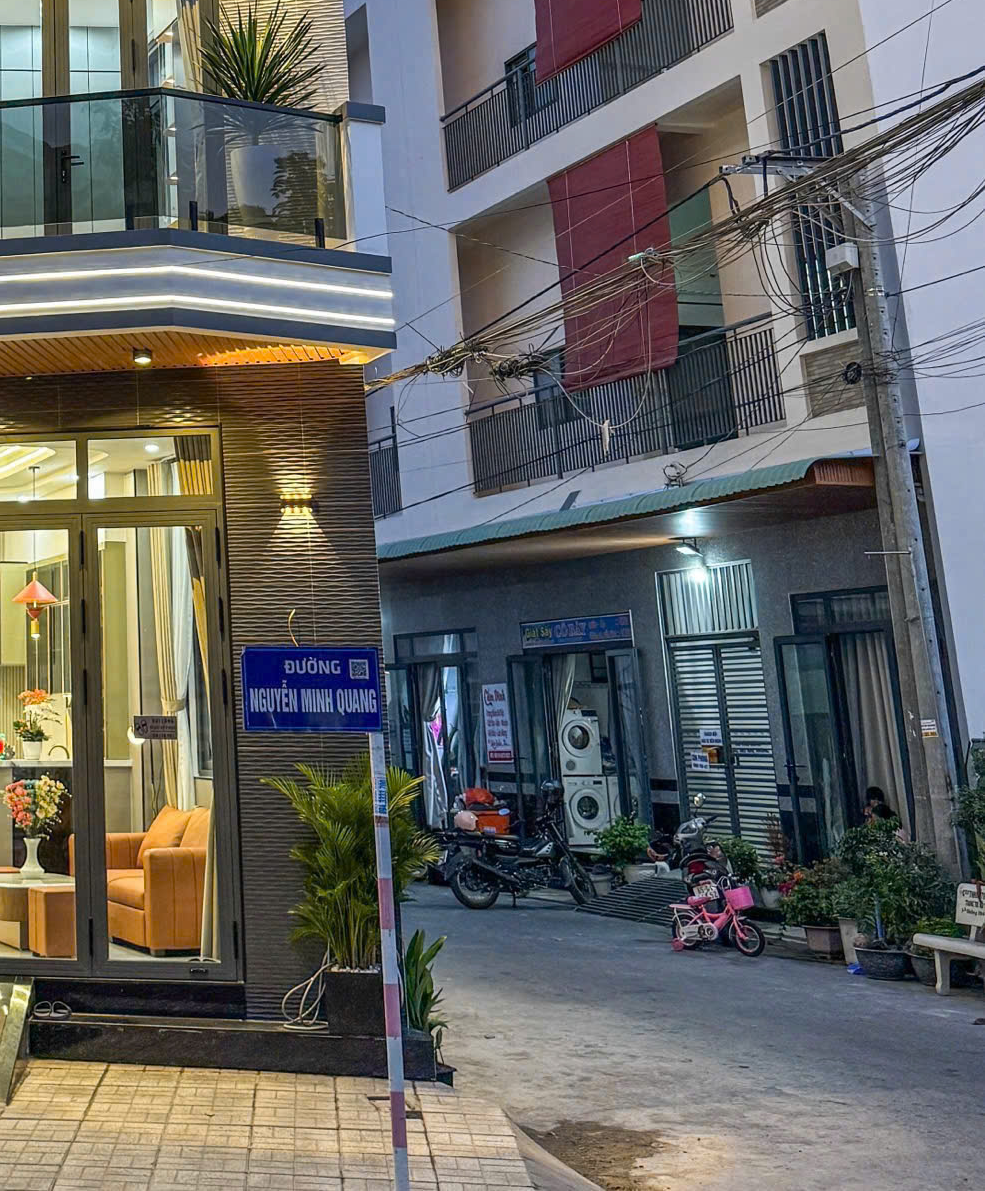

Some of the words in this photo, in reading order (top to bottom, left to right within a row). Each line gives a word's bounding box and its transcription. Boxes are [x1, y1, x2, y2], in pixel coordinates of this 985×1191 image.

[284, 657, 341, 674] ĐƯỜNG
[250, 680, 298, 713] NGUYỄN
[301, 688, 333, 713] MINH
[337, 688, 377, 715] QUANG
